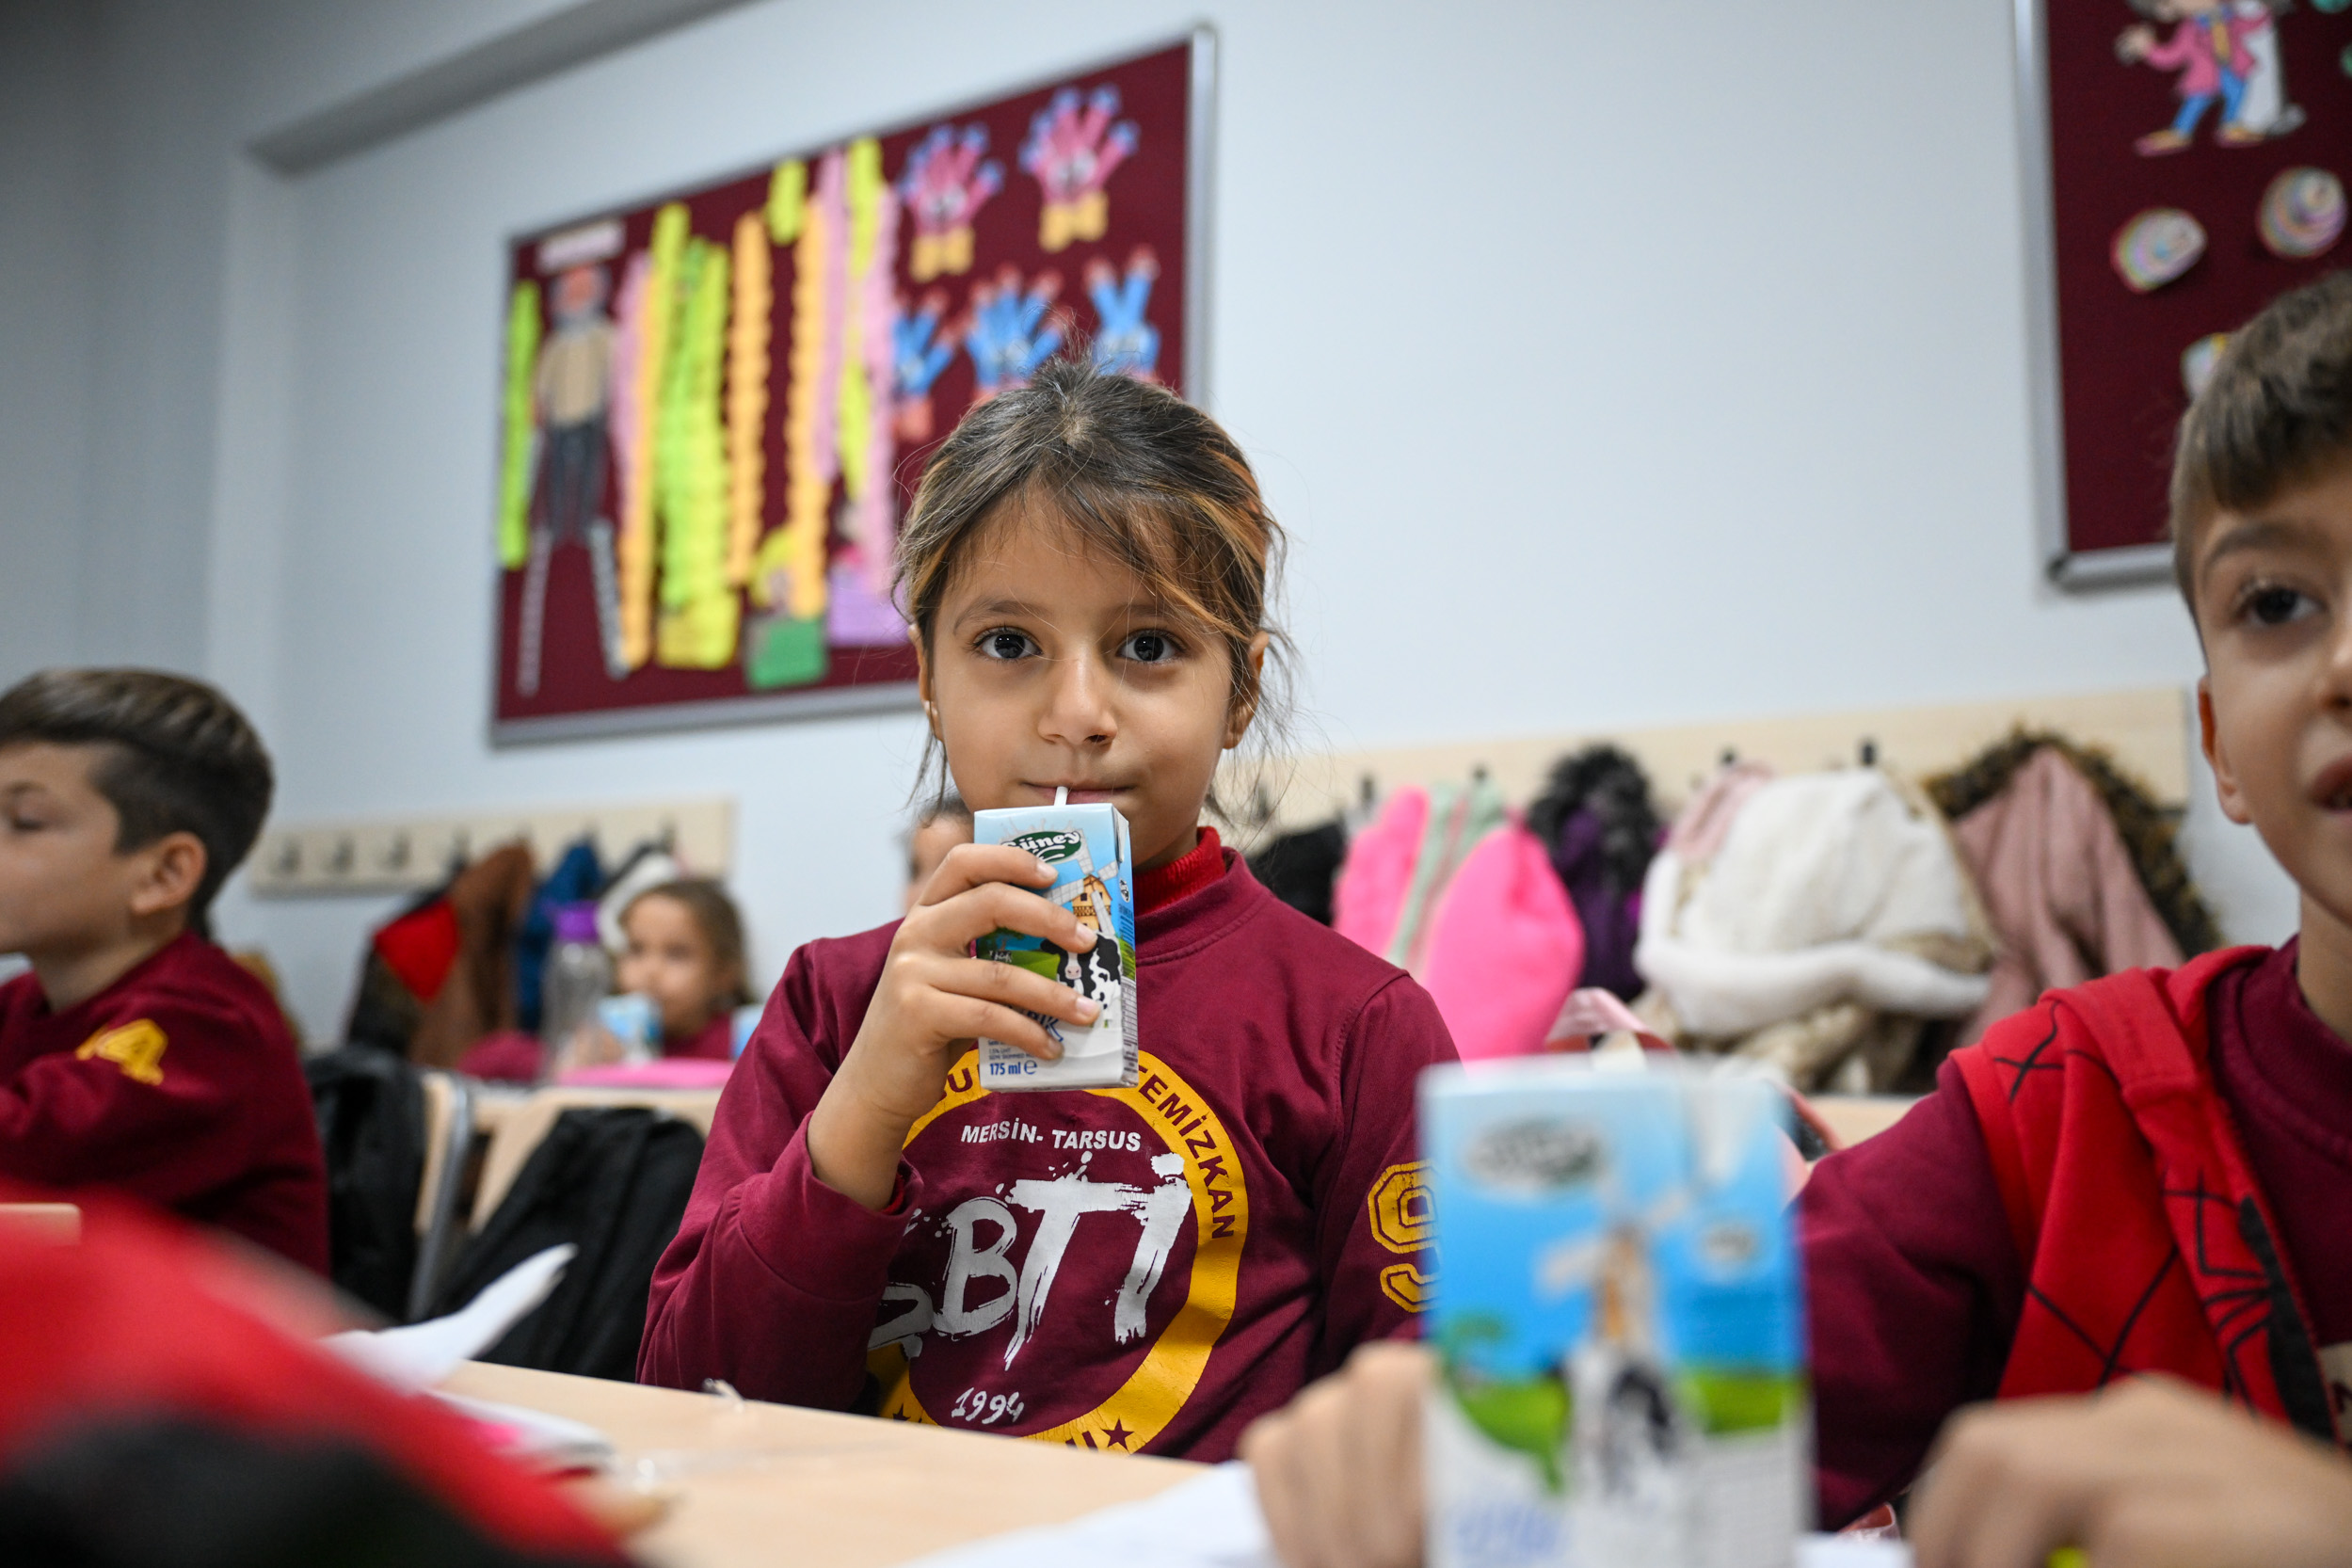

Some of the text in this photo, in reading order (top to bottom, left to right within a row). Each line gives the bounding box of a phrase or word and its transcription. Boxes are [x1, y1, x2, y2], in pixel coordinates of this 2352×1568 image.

[1001, 831, 1080, 851] üney
[990, 1063, 1006, 1076] 175
[1008, 1062, 1021, 1075] ml
[1051, 1128, 1141, 1152] TARSUS
[951, 1386, 1025, 1425] 1994
